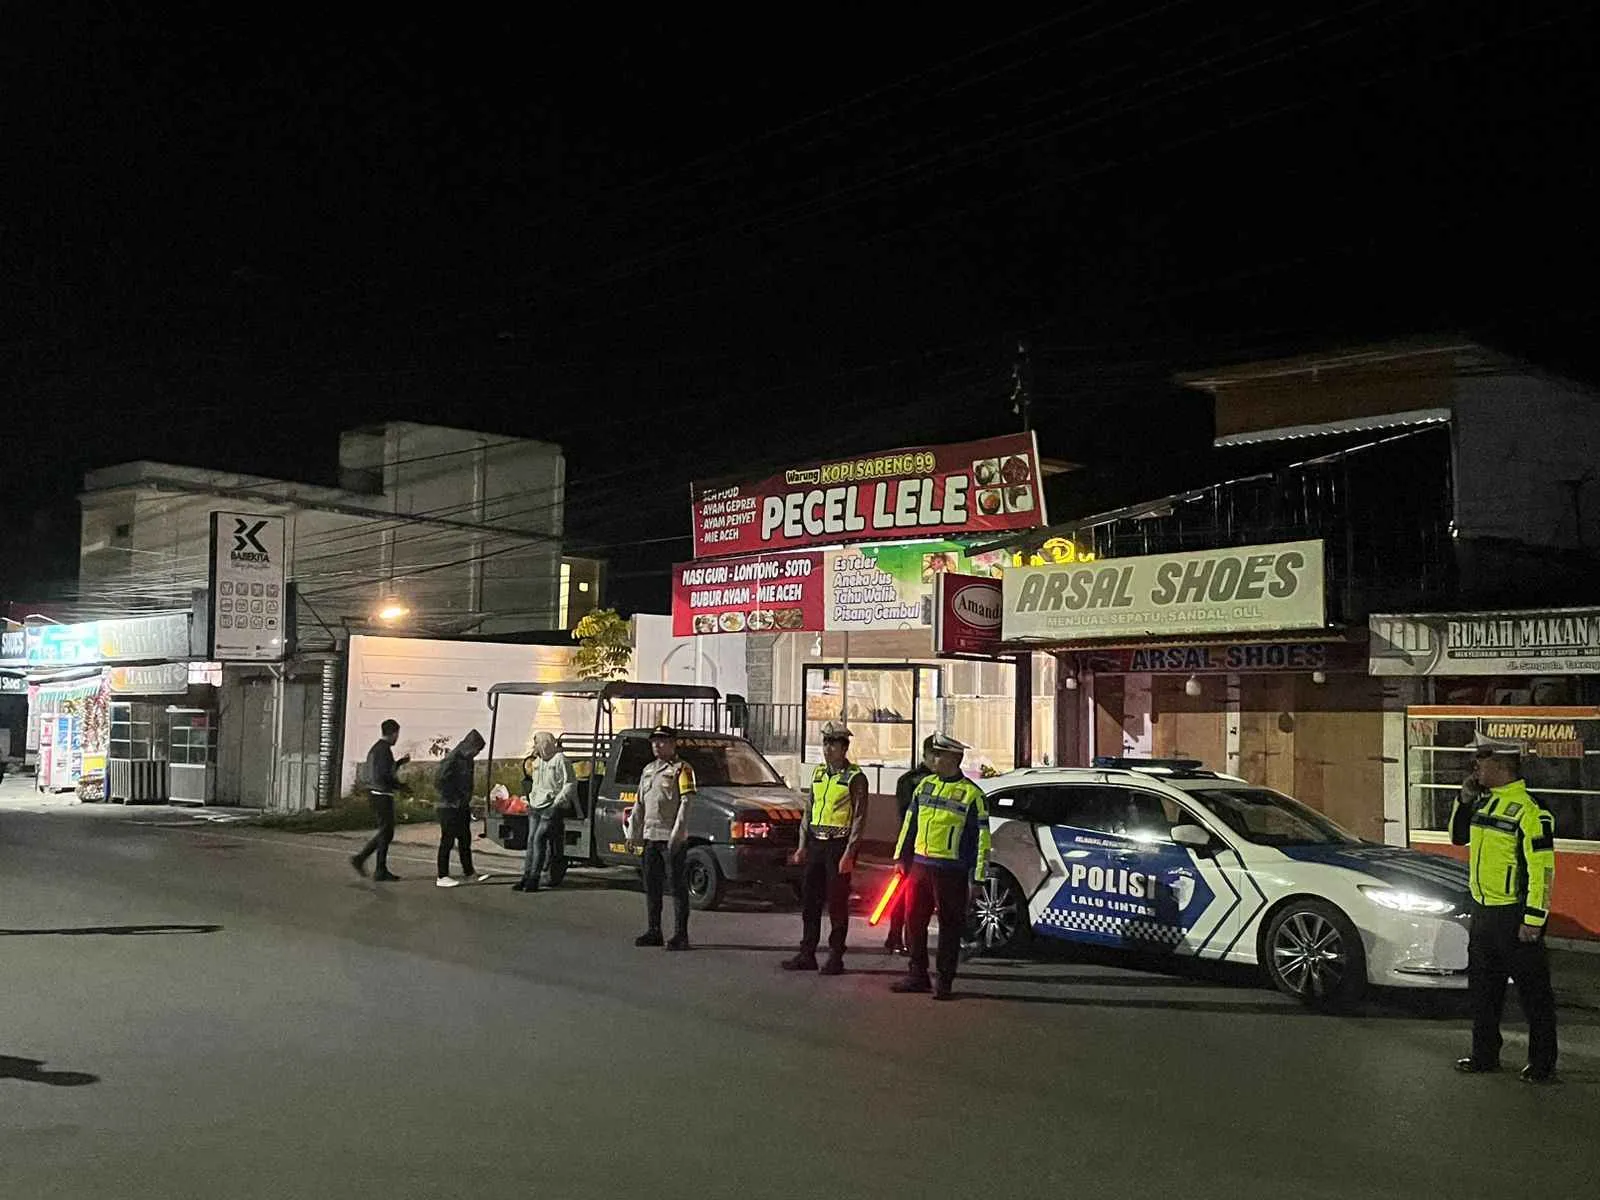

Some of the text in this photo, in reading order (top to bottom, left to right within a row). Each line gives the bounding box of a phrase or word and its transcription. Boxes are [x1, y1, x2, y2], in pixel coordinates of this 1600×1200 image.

[787, 453, 936, 483] Warung KOPI SARENG 99
[703, 497, 757, 516] AYAM GEPREK
[762, 476, 968, 541] PECEL LELE
[704, 515, 726, 530] AYAM
[704, 528, 740, 544] MIE ACEH
[682, 559, 812, 586] NASI GURI LONTONG SOTO
[834, 554, 877, 571] Es Teler
[833, 570, 893, 588] Aneka Jus
[1015, 566, 1133, 613] ARSAL
[1150, 551, 1305, 605] SHOES
[690, 583, 803, 608] BUBUR AYAM MIE ACEH
[834, 586, 896, 604] Tahu Walik
[833, 602, 921, 624] Pisang Gembul
[957, 595, 1003, 619] Amand
[1047, 614, 1106, 627] MENJUAL
[1447, 620, 1513, 648] RUMAH
[1520, 617, 1589, 647] MAKAN
[1131, 645, 1325, 671] ARSAL SHOES
[1071, 864, 1157, 900] POLISI
[1071, 894, 1156, 916] LALU LINTAS
